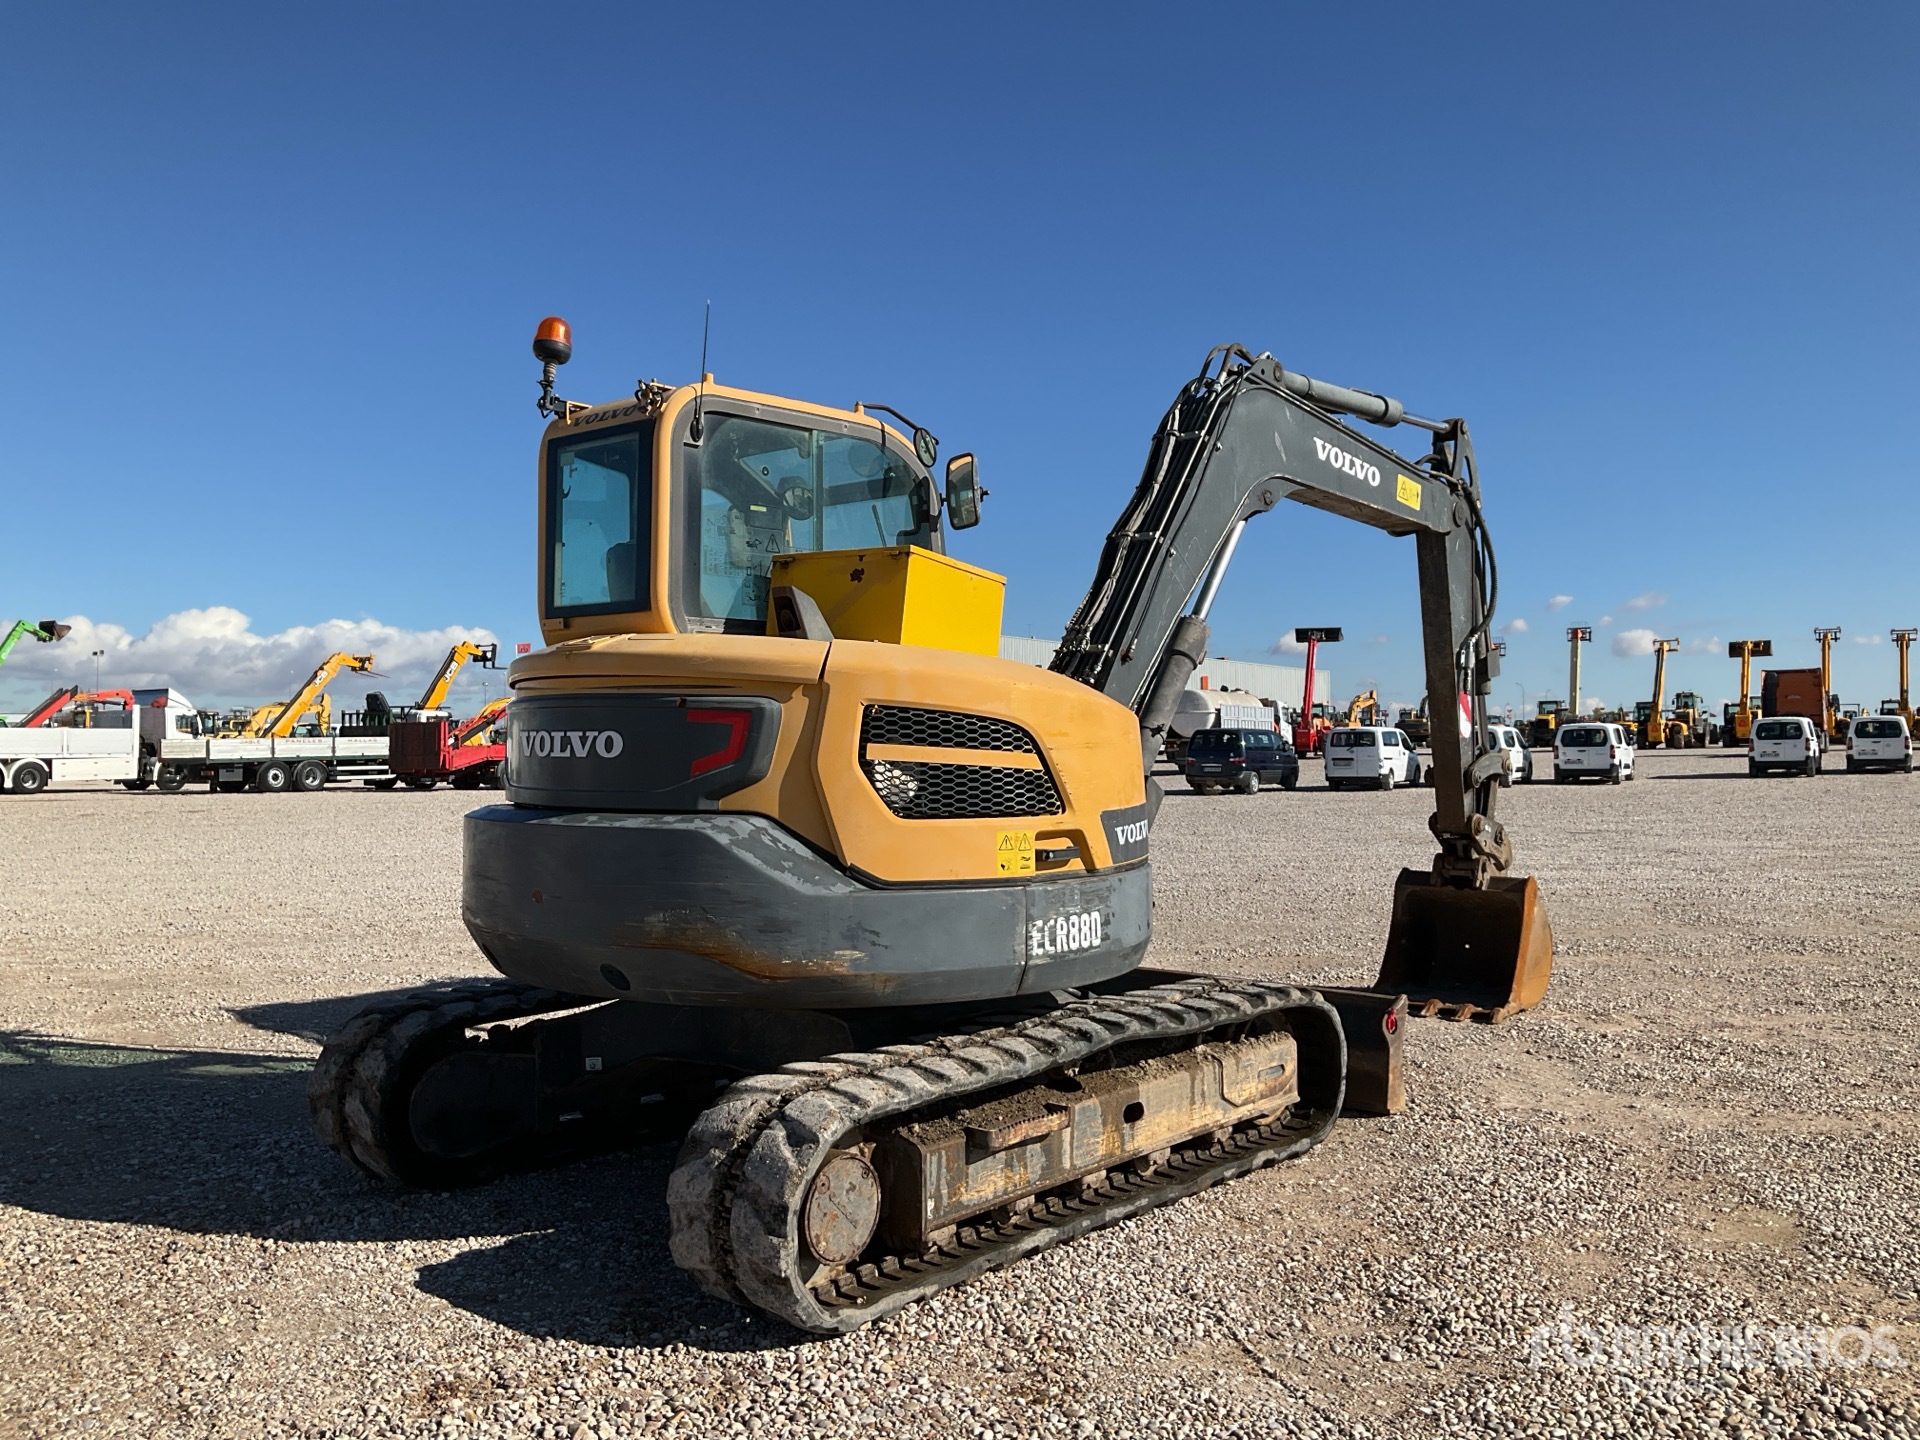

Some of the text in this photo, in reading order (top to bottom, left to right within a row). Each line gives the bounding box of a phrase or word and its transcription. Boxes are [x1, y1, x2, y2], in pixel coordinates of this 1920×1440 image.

[573, 403, 639, 427] VOLVO
[1313, 436, 1381, 487] VOLVO
[314, 669, 329, 688] JCB
[444, 660, 459, 683] JCB
[520, 730, 624, 758] VOLVO
[1114, 819, 1149, 846] VOLV
